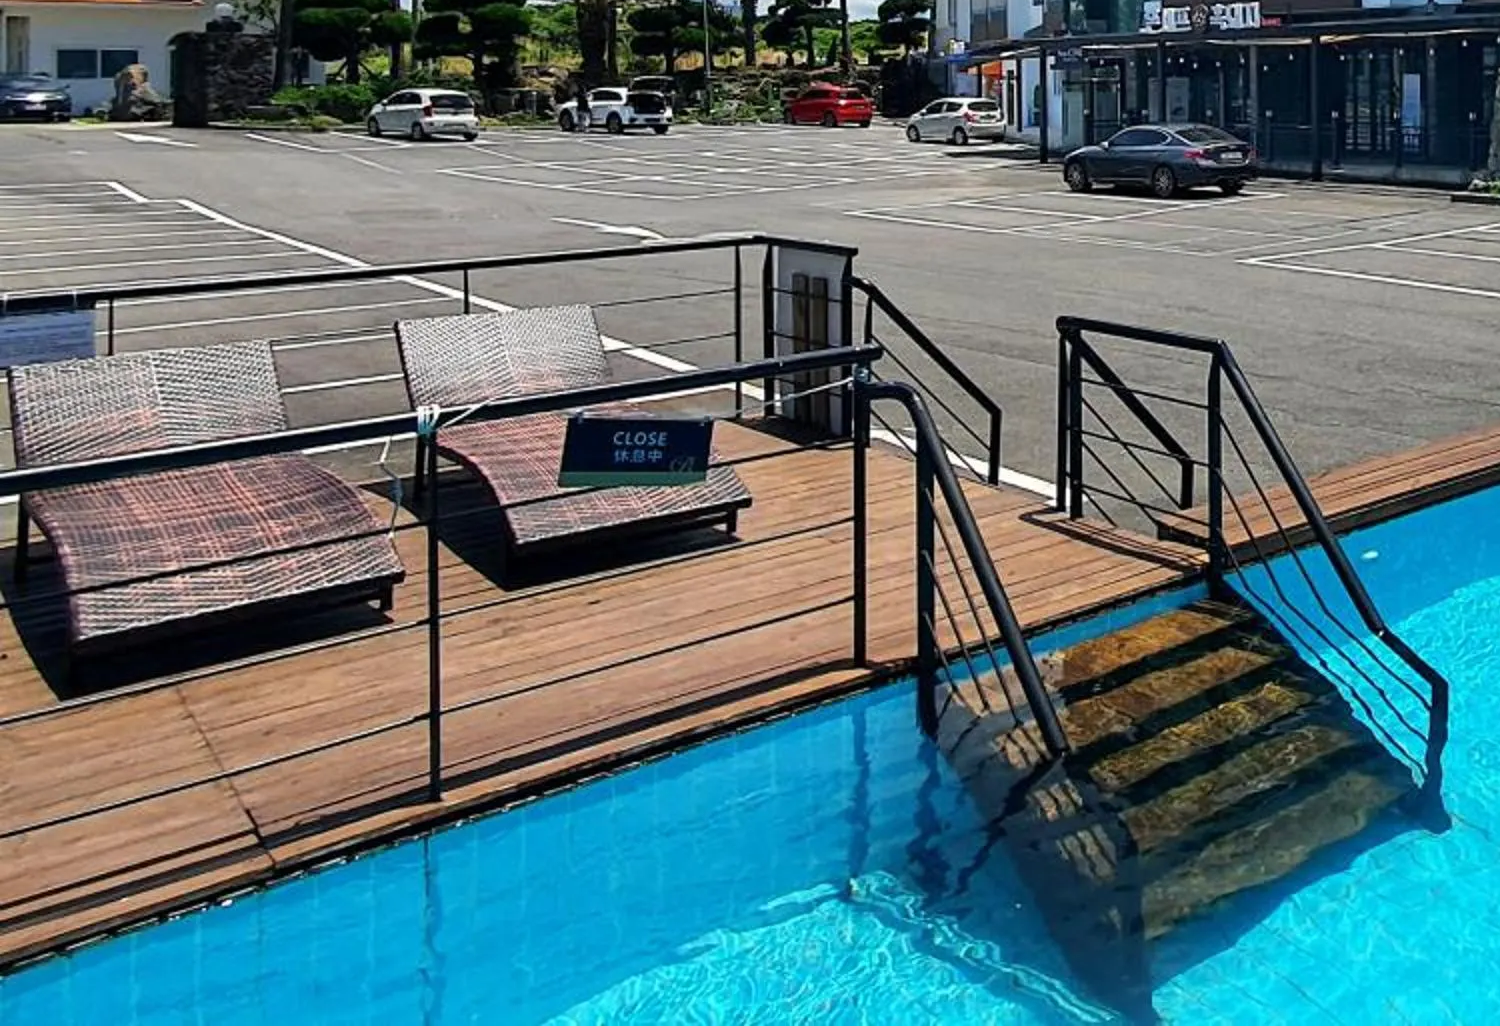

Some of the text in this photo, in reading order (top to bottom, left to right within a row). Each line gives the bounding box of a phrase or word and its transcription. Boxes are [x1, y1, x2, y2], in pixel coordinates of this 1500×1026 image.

[613, 431, 669, 447] CLOSE
[614, 448, 663, 464] 休息中
